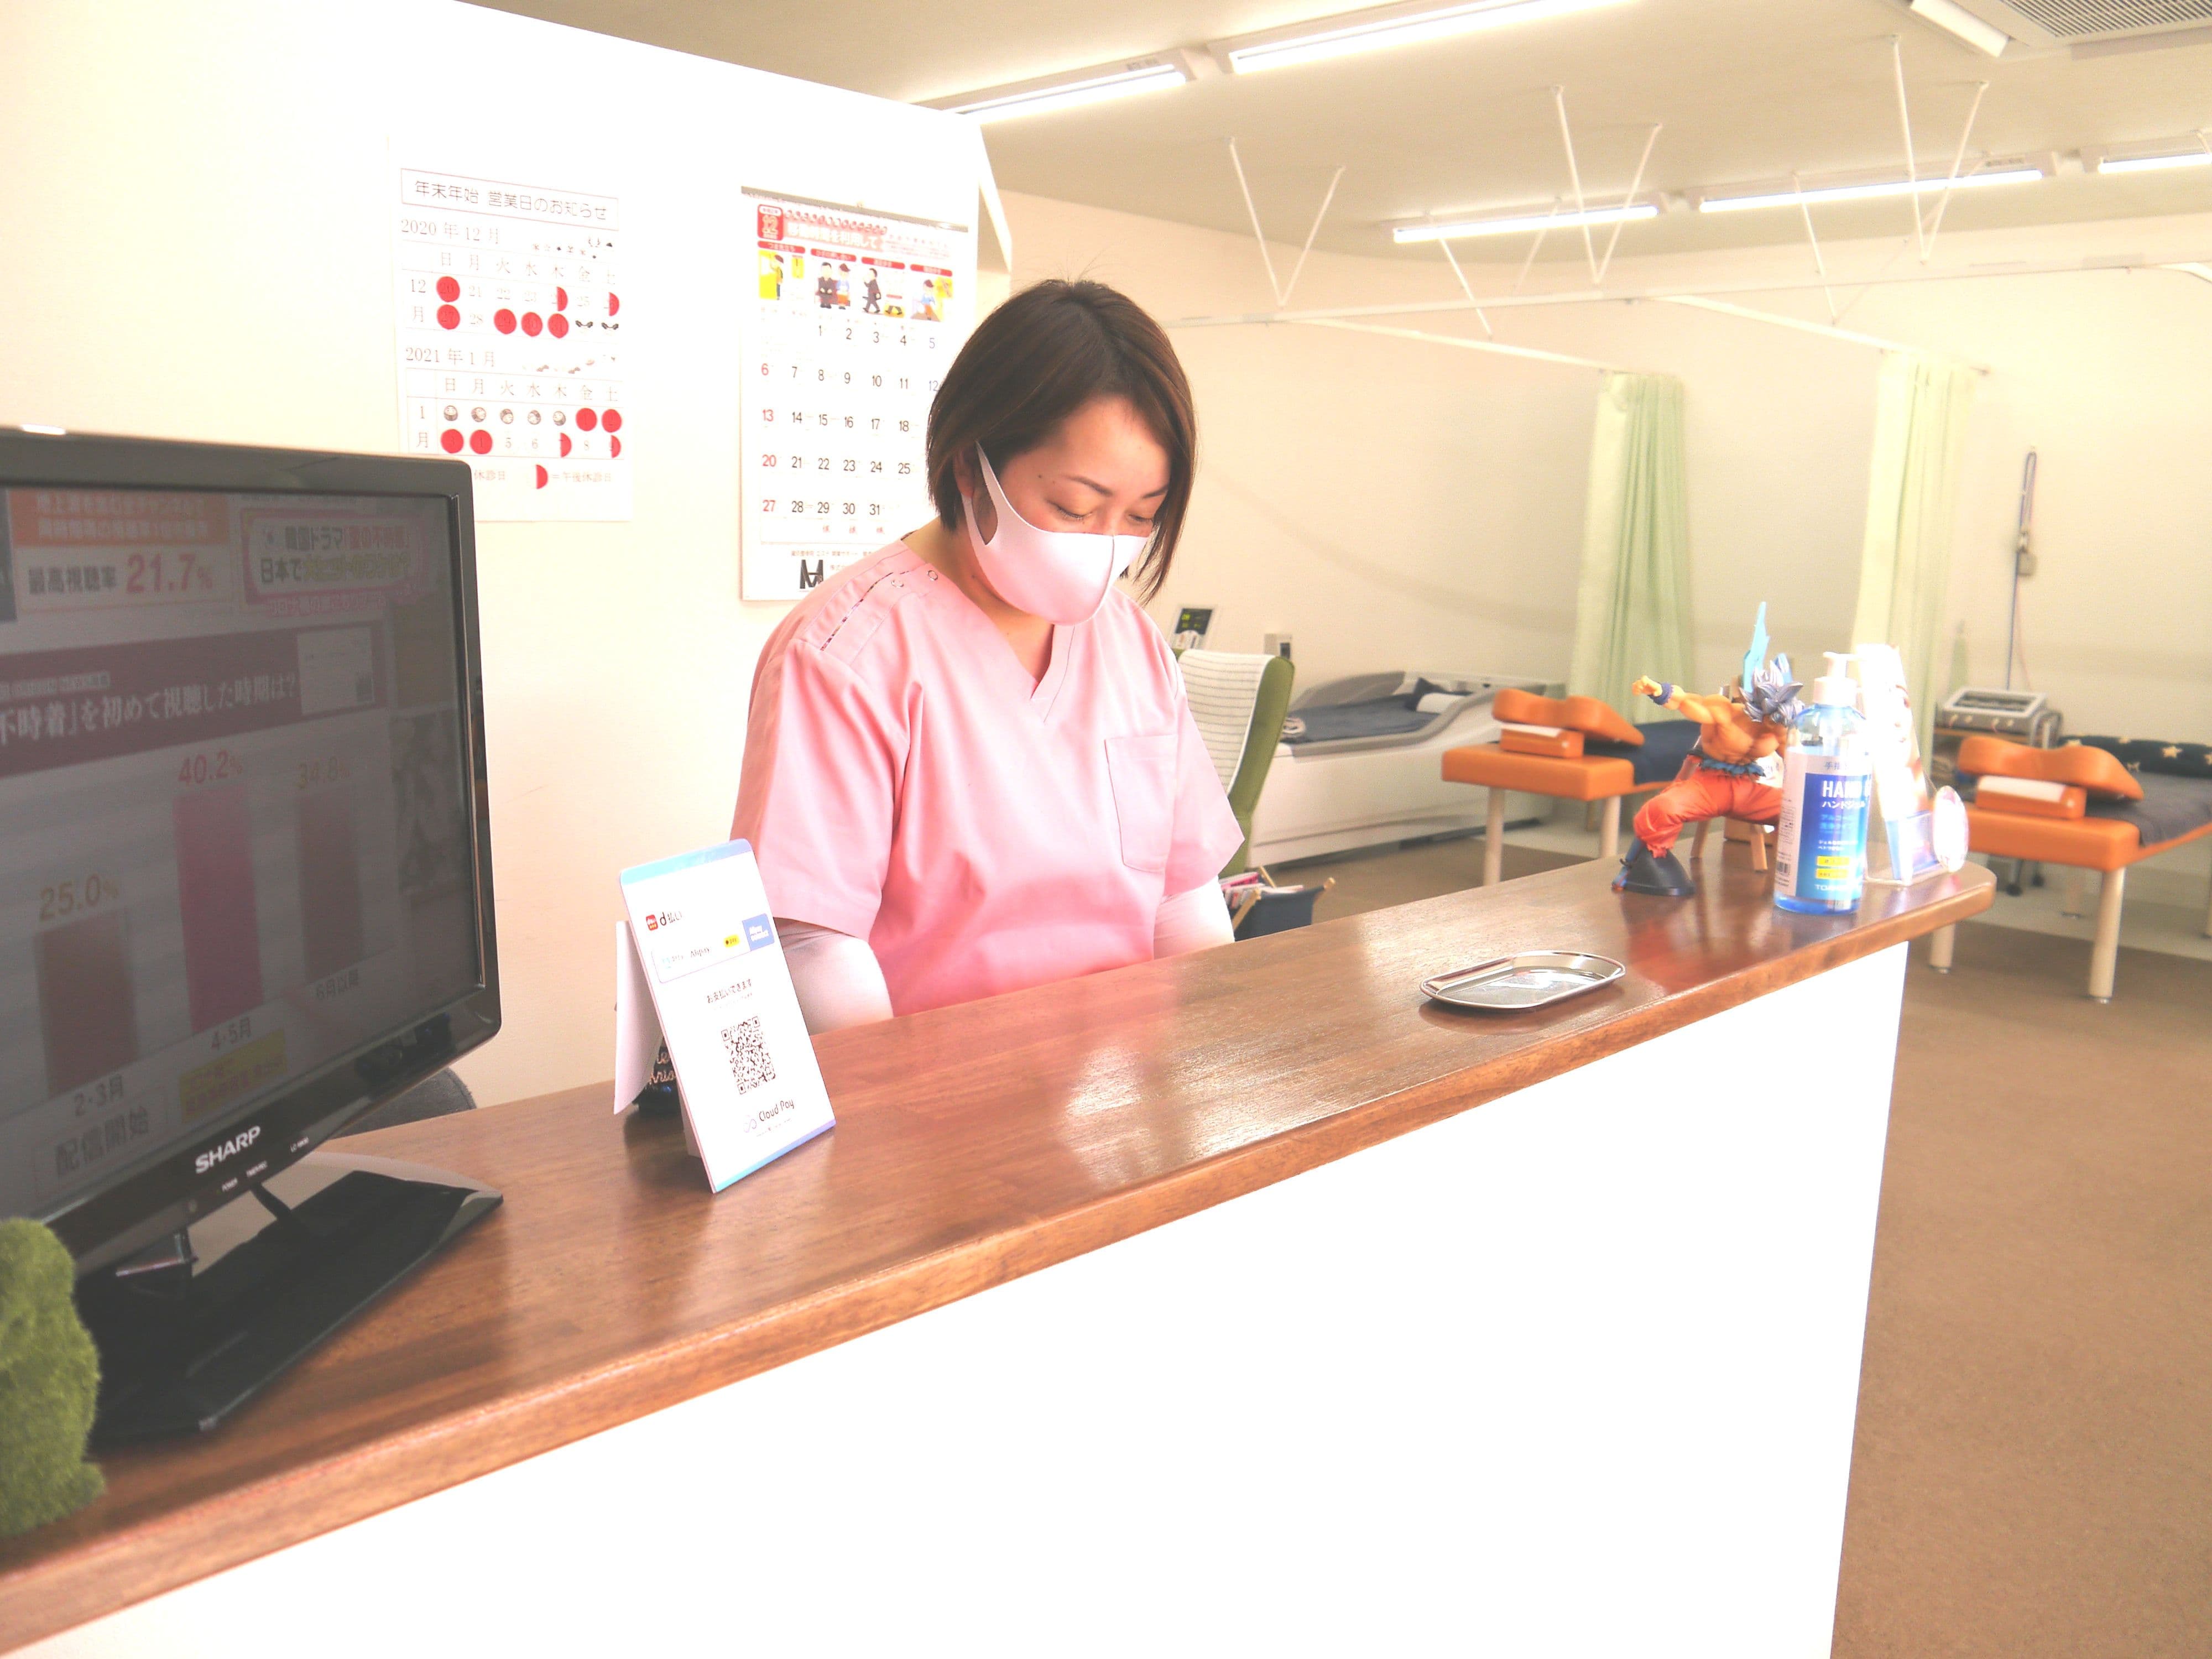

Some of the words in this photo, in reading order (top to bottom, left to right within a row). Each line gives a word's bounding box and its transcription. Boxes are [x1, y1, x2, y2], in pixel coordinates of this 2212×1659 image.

[415, 181, 479, 204] 年末年始
[488, 190, 607, 220] 営業日のお知らせ
[401, 219, 436, 236] 2020
[444, 222, 460, 239] 年
[465, 227, 480, 242] 12
[489, 228, 499, 244] 月
[441, 252, 451, 267] 日
[469, 254, 480, 271] 月
[495, 258, 511, 274] 火
[410, 278, 426, 294] 12
[496, 289, 511, 300] 22
[413, 306, 424, 323] 月
[846, 328, 852, 340] 2
[873, 331, 880, 343] 3
[900, 335, 907, 346] 4
[929, 337, 936, 349] 5
[405, 347, 440, 363] 2021
[446, 348, 463, 366] 年
[484, 351, 496, 367] 月
[761, 363, 769, 376] 6
[792, 366, 798, 378] 7
[818, 369, 825, 381] 8
[844, 372, 851, 384] 9
[872, 375, 883, 387] 10
[900, 378, 909, 389] 11
[928, 380, 939, 392] 12
[445, 377, 456, 393] 日
[472, 378, 484, 395] 月
[500, 380, 515, 397] 火
[526, 381, 541, 398] 水
[554, 383, 567, 398] 木
[579, 384, 593, 401] 金
[607, 387, 619, 402] 土
[419, 406, 425, 419] 1
[762, 409, 774, 422] 13
[792, 411, 802, 424] 14
[818, 414, 828, 426] 15
[844, 416, 854, 428] 16
[872, 418, 880, 430] 17
[899, 420, 910, 432] 18
[415, 431, 429, 448] 月
[504, 437, 513, 449] 5
[531, 438, 539, 450] 6
[762, 454, 776, 468] 20
[791, 456, 802, 468] 21
[818, 457, 830, 470] 22
[843, 460, 855, 472] 23
[870, 461, 883, 473] 24
[898, 462, 911, 474] 25
[473, 469, 506, 482] 休診日
[762, 499, 776, 512] 27
[791, 500, 804, 513] 28
[817, 501, 830, 514] 29
[842, 503, 855, 515] 30
[869, 504, 880, 515] 31
[126, 554, 213, 594] 21.7%
[177, 749, 244, 787] 40.2%
[39, 873, 119, 923] 25.0%
[706, 978, 753, 1004] お支払いできます
[759, 1103, 780, 1123] Cloud
[780, 1098, 795, 1114] Pay
[195, 1125, 262, 1175] SHARP
